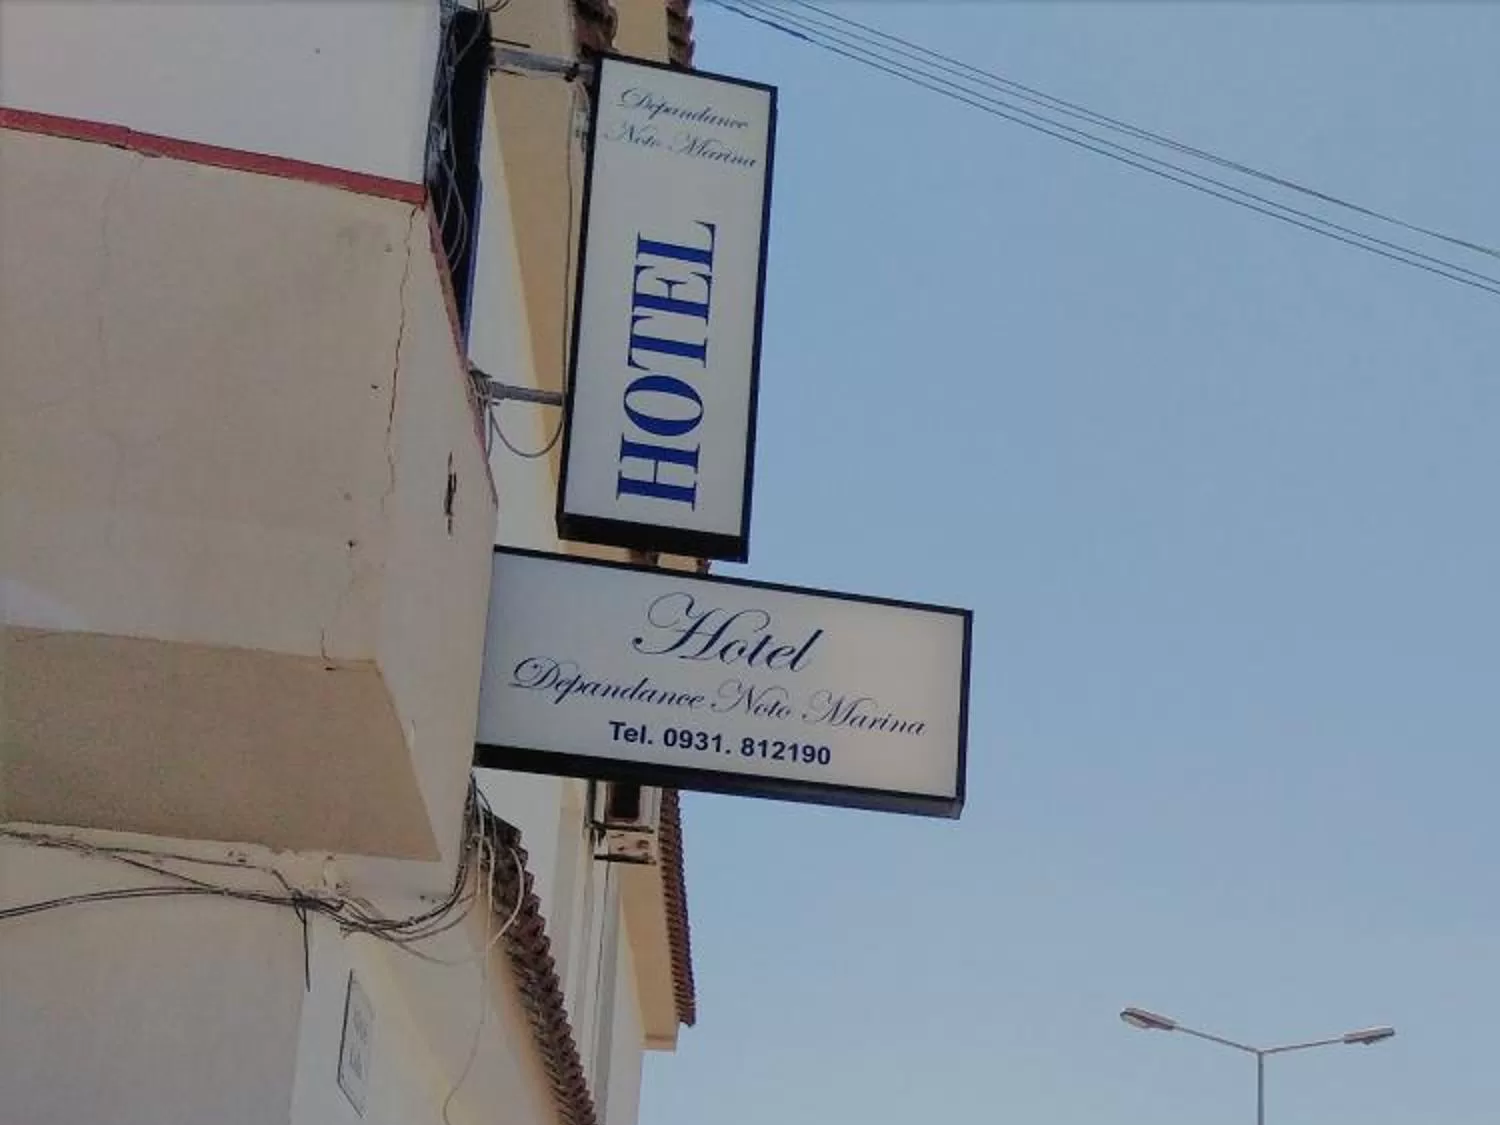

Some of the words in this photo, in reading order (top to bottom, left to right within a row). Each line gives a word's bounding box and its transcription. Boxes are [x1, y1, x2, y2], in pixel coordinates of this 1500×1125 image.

[669, 132, 758, 168] Marina
[616, 220, 717, 511] HOTEL
[632, 591, 824, 673] Hotel
[508, 656, 706, 708] Depandance
[710, 678, 793, 720] Noto
[801, 689, 928, 737] Marina
[608, 719, 653, 745] Tel.
[663, 727, 732, 755] 0931.
[740, 737, 832, 766] 812190
